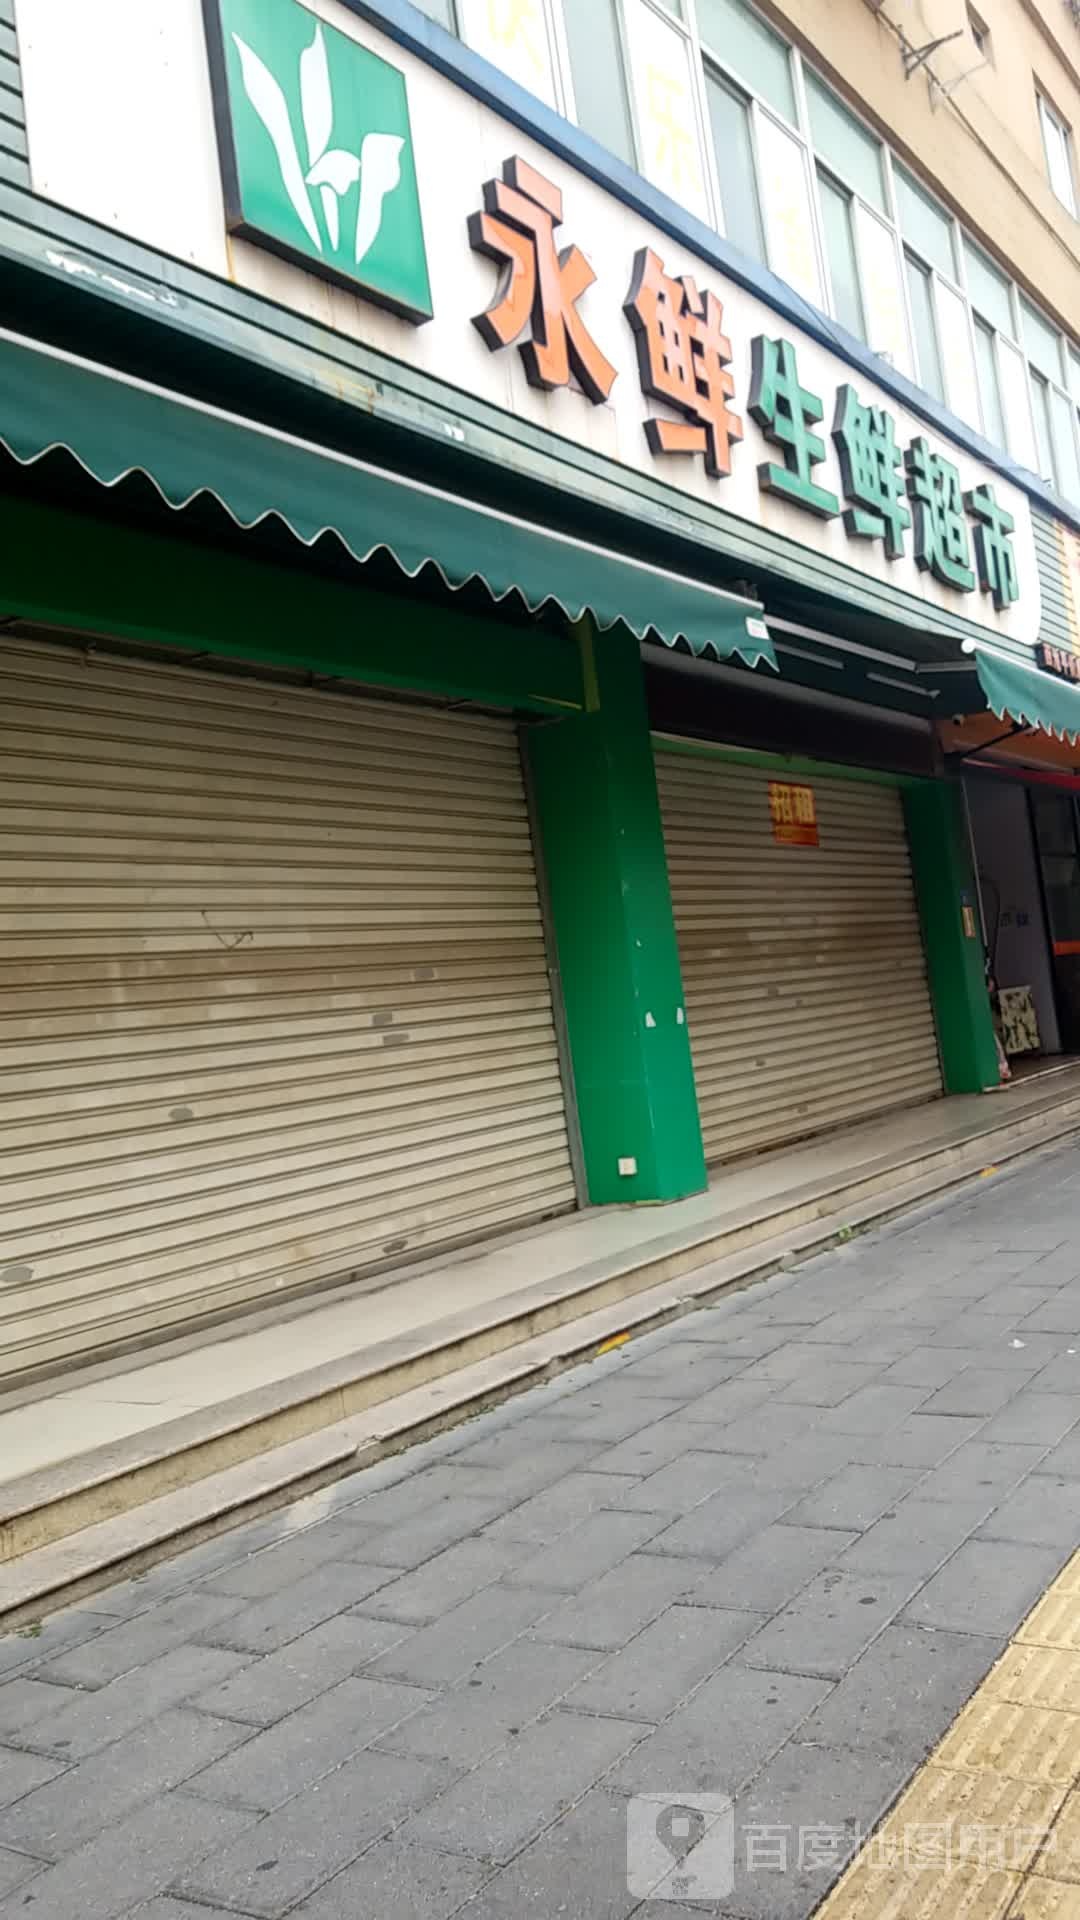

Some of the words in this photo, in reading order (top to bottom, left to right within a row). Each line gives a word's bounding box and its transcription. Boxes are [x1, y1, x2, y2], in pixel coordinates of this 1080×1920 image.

[467, 155, 1020, 612] 永鲜生鲜超市
[768, 783, 816, 825] 招租
